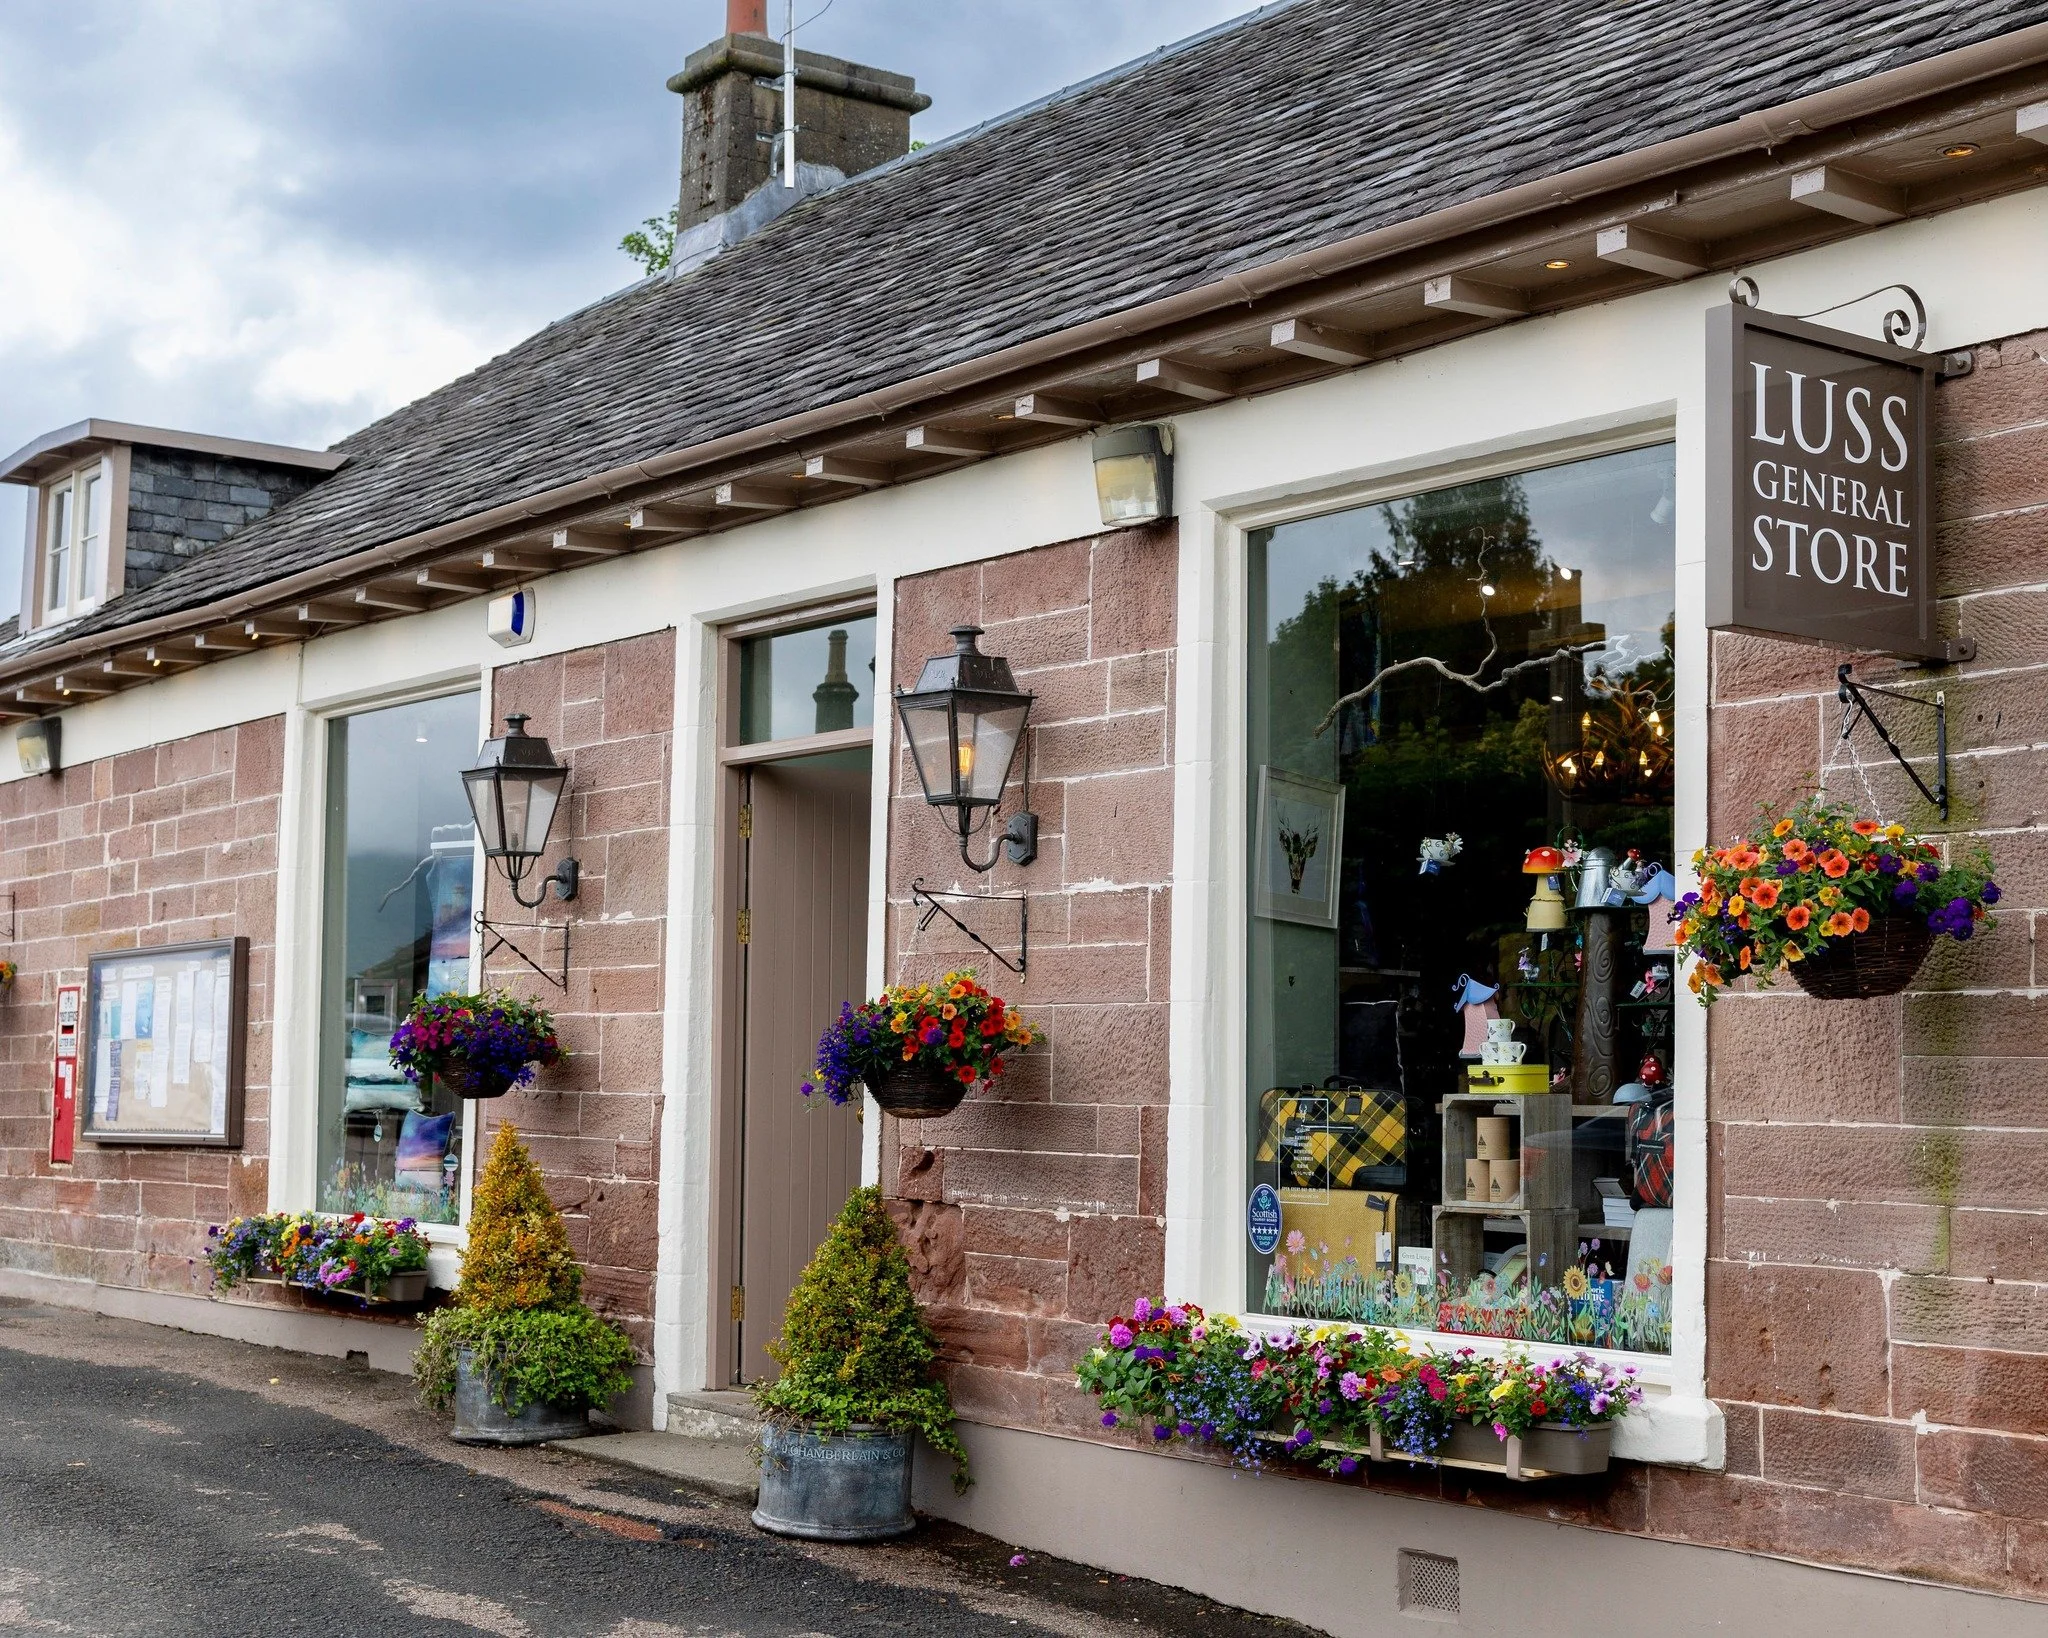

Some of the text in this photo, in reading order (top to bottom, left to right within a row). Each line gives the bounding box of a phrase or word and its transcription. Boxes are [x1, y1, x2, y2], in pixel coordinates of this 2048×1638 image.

[1749, 361, 1908, 472] LUSS
[1752, 460, 1911, 528] GENERAL
[1752, 515, 1909, 597] STORE
[1251, 1207, 1278, 1218] Scottish
[1401, 1252, 1431, 1262] Green Living
